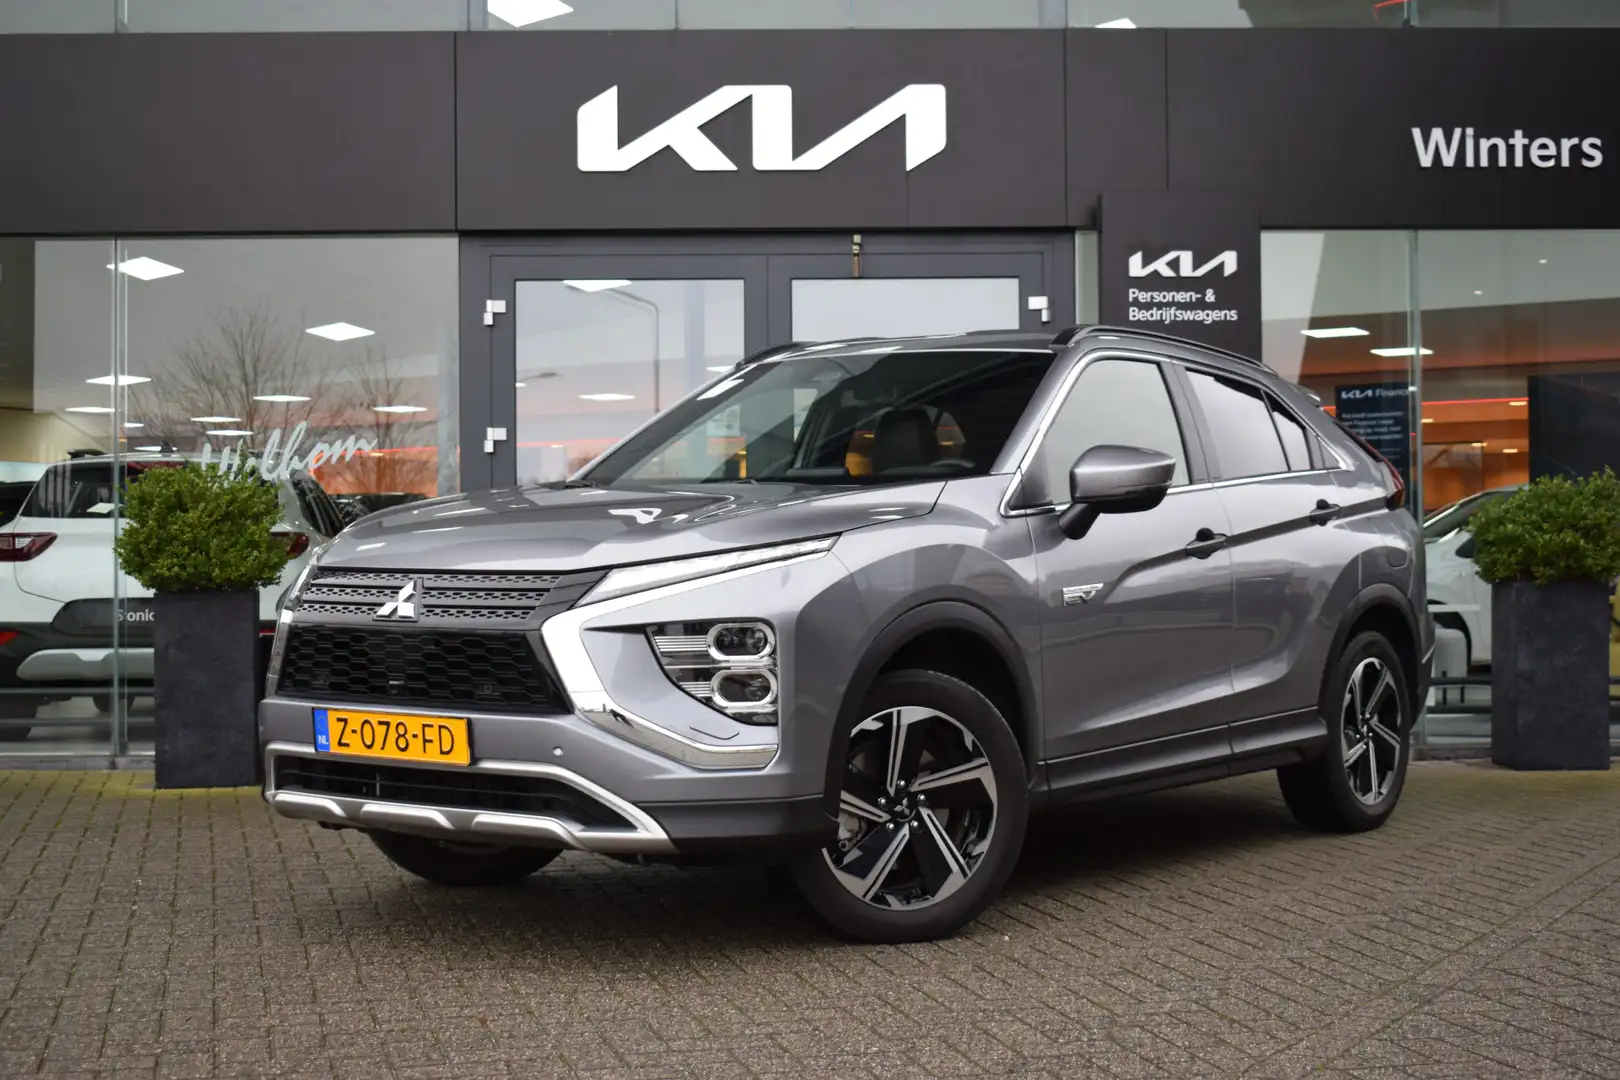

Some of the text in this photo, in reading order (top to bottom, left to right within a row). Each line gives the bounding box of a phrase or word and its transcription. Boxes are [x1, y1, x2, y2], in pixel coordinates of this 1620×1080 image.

[577, 83, 947, 172] KIA
[1411, 126, 1604, 168] Winters
[1128, 250, 1238, 277] KIA
[1128, 288, 1216, 303] Personen- &
[1128, 306, 1238, 325] Bedrijfswagens
[1375, 387, 1411, 398] Financ
[317, 734, 329, 745] NL
[335, 716, 455, 756] Z-078-FD
